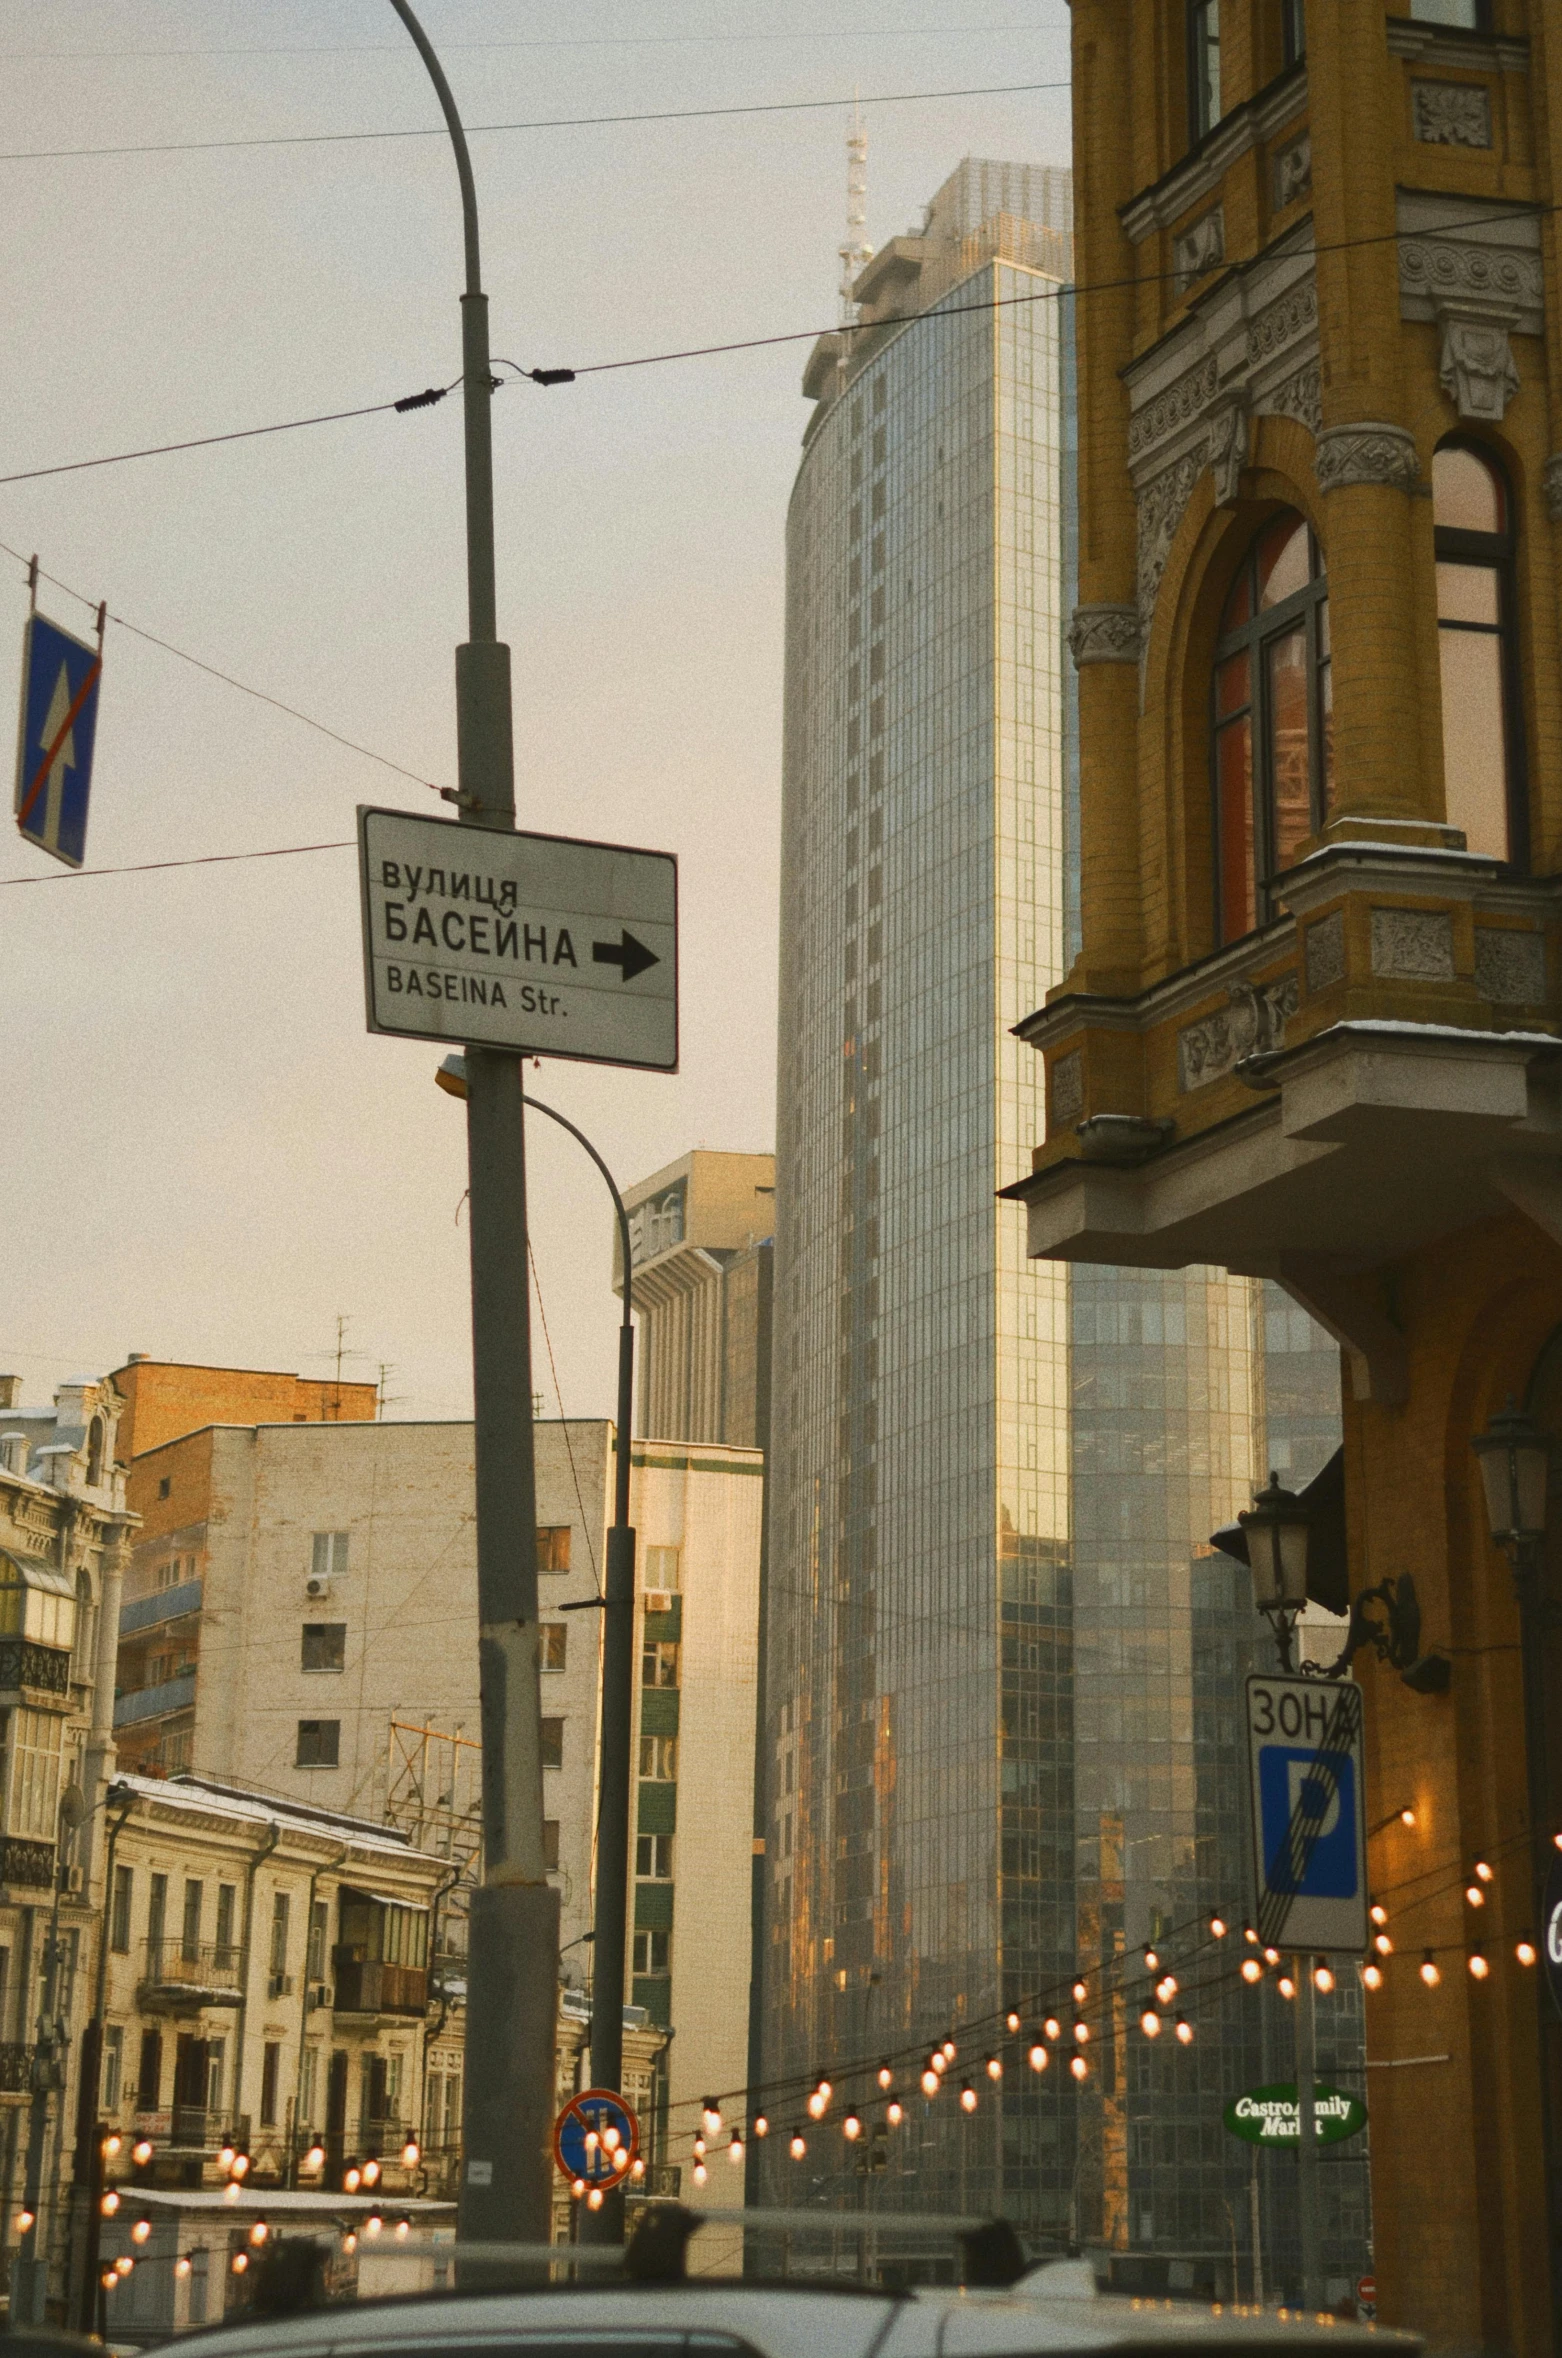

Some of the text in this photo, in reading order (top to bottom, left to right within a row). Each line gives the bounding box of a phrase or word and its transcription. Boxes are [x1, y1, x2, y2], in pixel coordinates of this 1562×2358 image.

[385, 902, 577, 968] БАСЕЙНА
[387, 966, 568, 1017] BASEINA Str.
[1235, 2095, 1351, 2120] Gastromily
